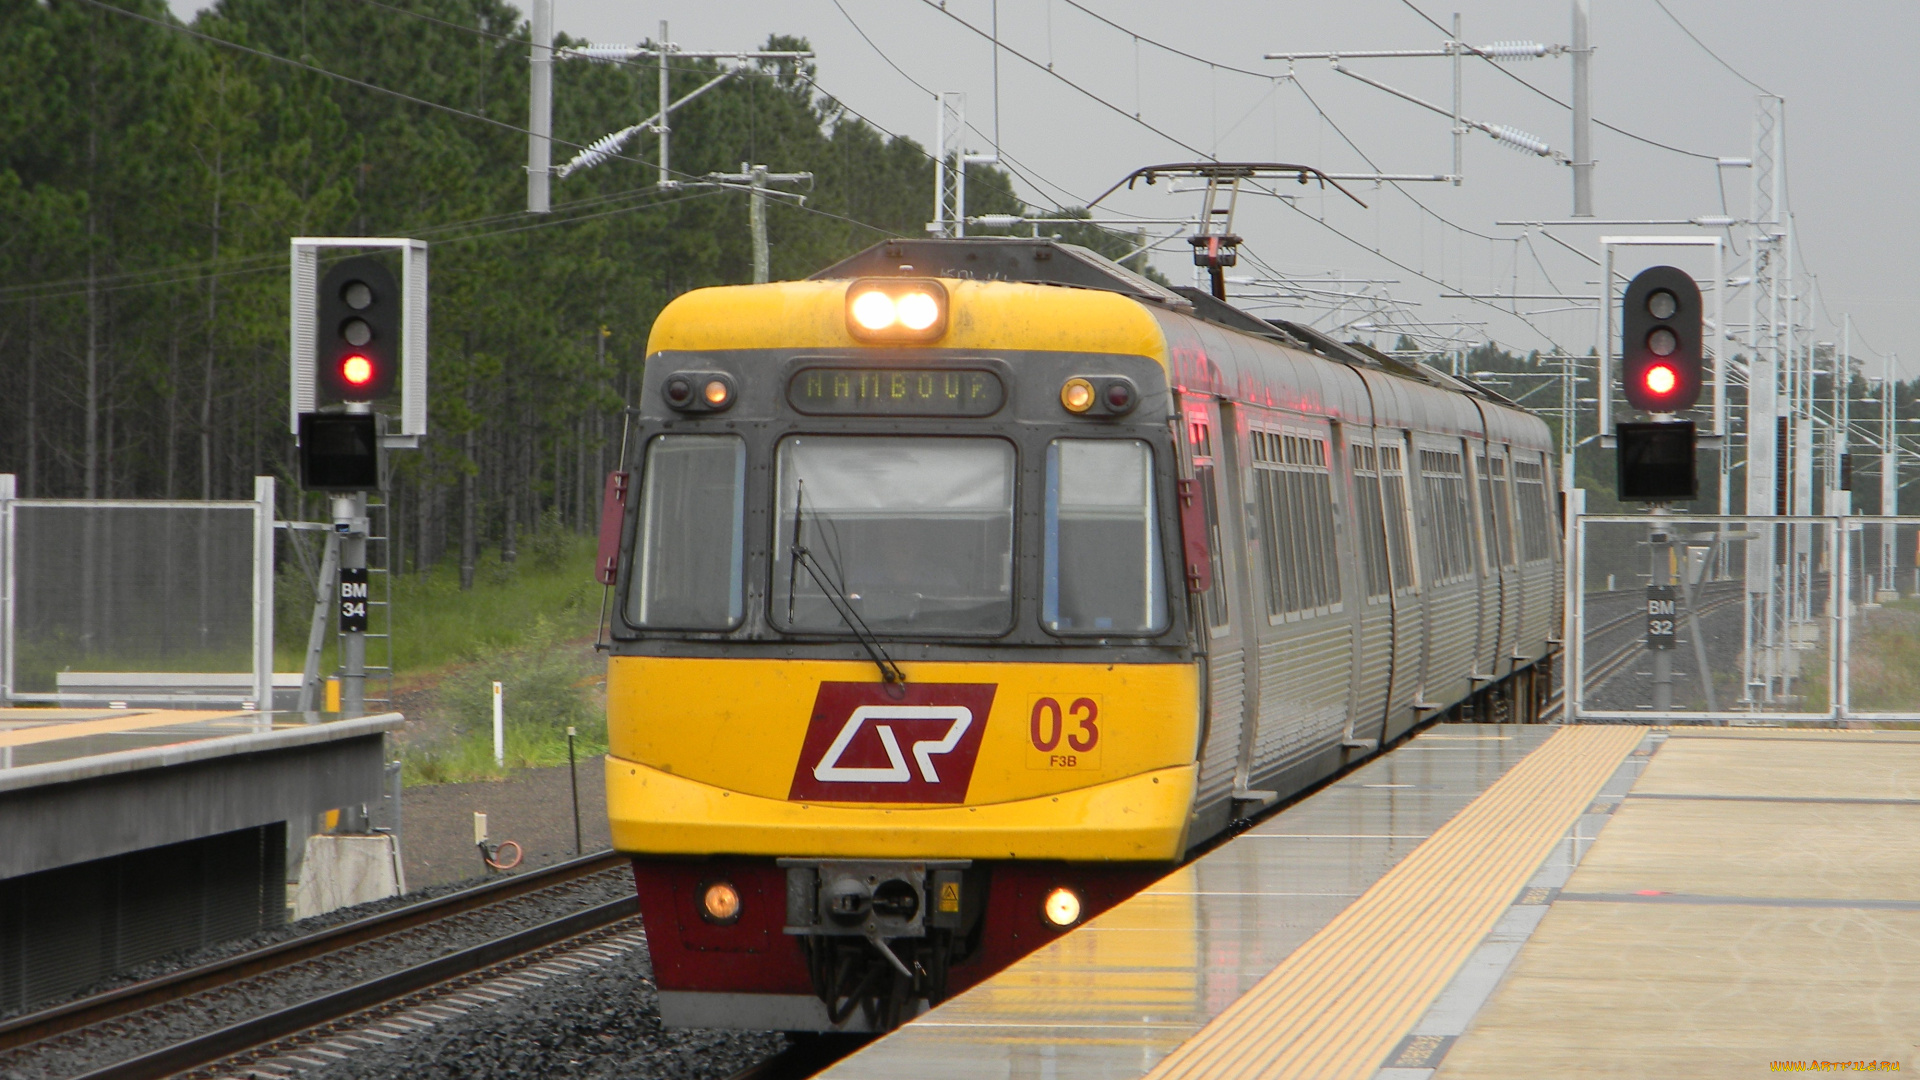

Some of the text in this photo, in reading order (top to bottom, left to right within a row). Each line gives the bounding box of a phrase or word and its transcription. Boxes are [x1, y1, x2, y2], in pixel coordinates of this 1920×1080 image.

[341, 582, 367, 598] BM
[342, 602, 365, 617] 34
[1648, 599, 1675, 615] BM
[1649, 619, 1674, 635] 32
[1030, 696, 1099, 753] 03
[1050, 755, 1077, 767] F3B
